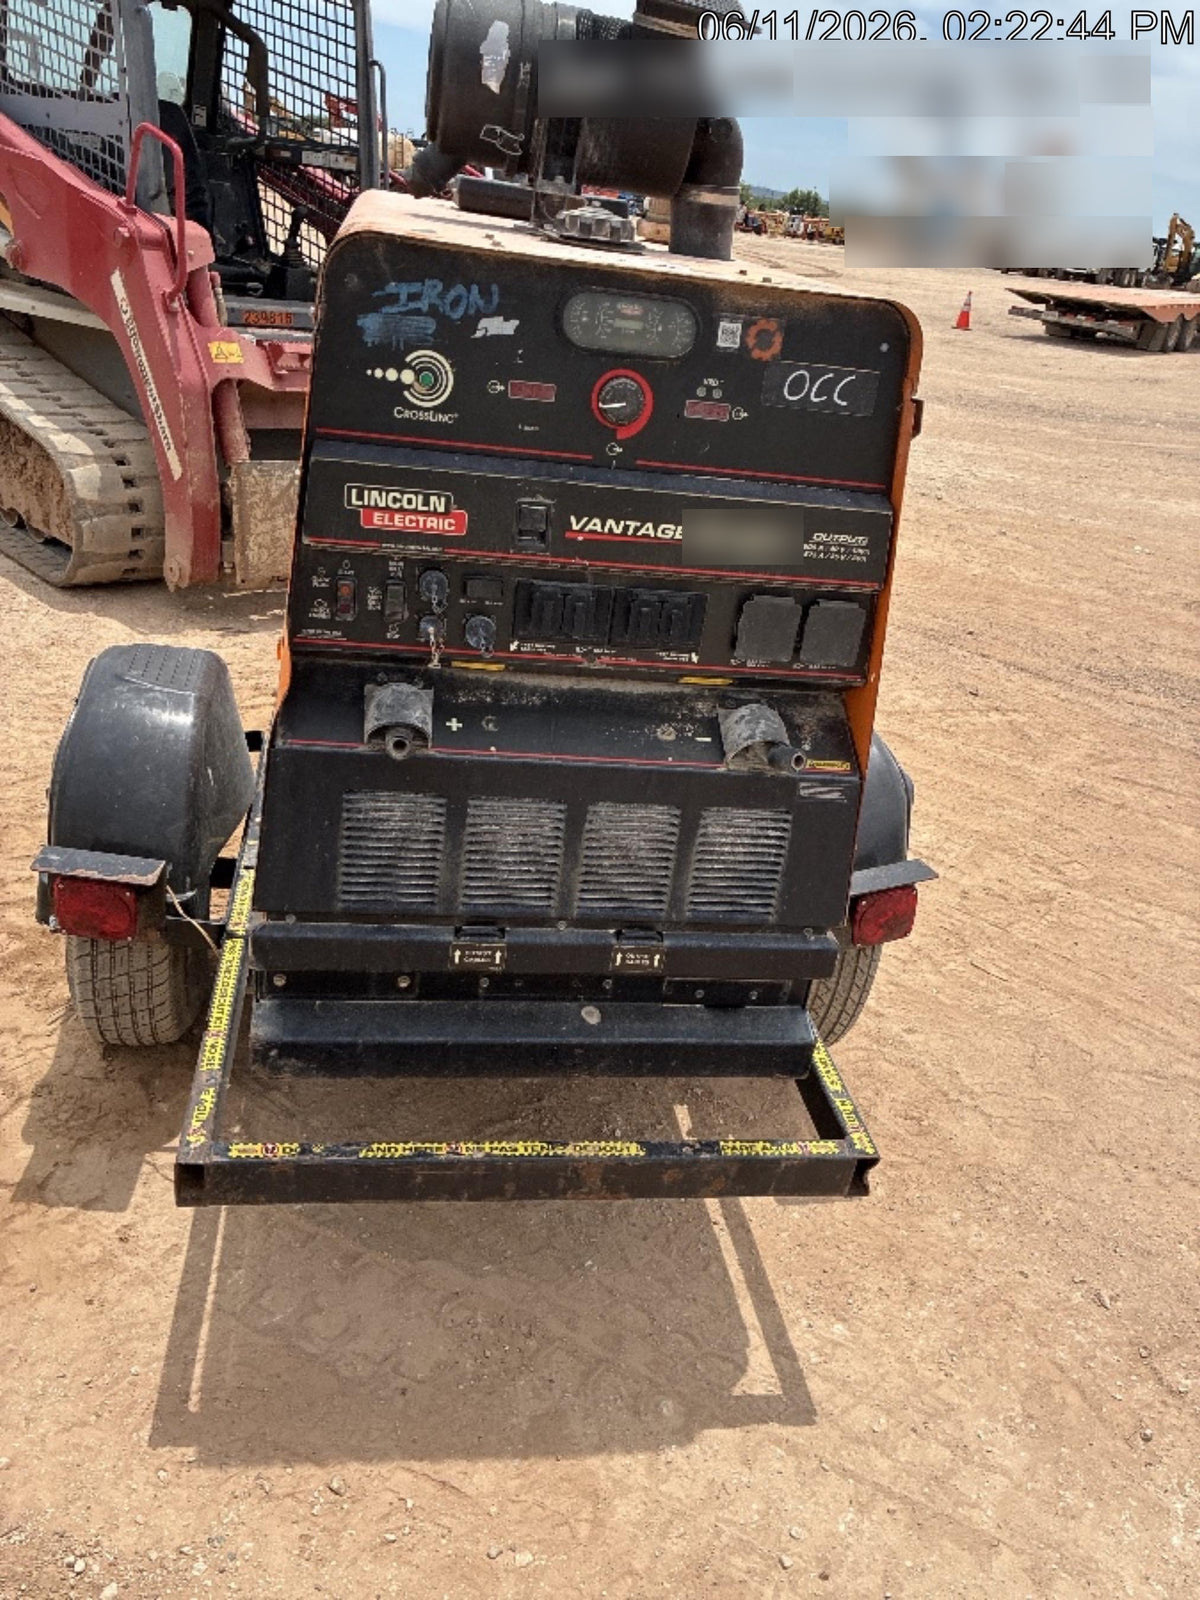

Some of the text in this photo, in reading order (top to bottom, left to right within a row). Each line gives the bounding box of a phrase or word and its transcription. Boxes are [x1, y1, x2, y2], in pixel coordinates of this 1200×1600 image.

[372, 279, 499, 320] IRON
[784, 370, 856, 405] OCC
[351, 488, 446, 513] LINCOLN
[372, 511, 456, 531] ELECTRIC
